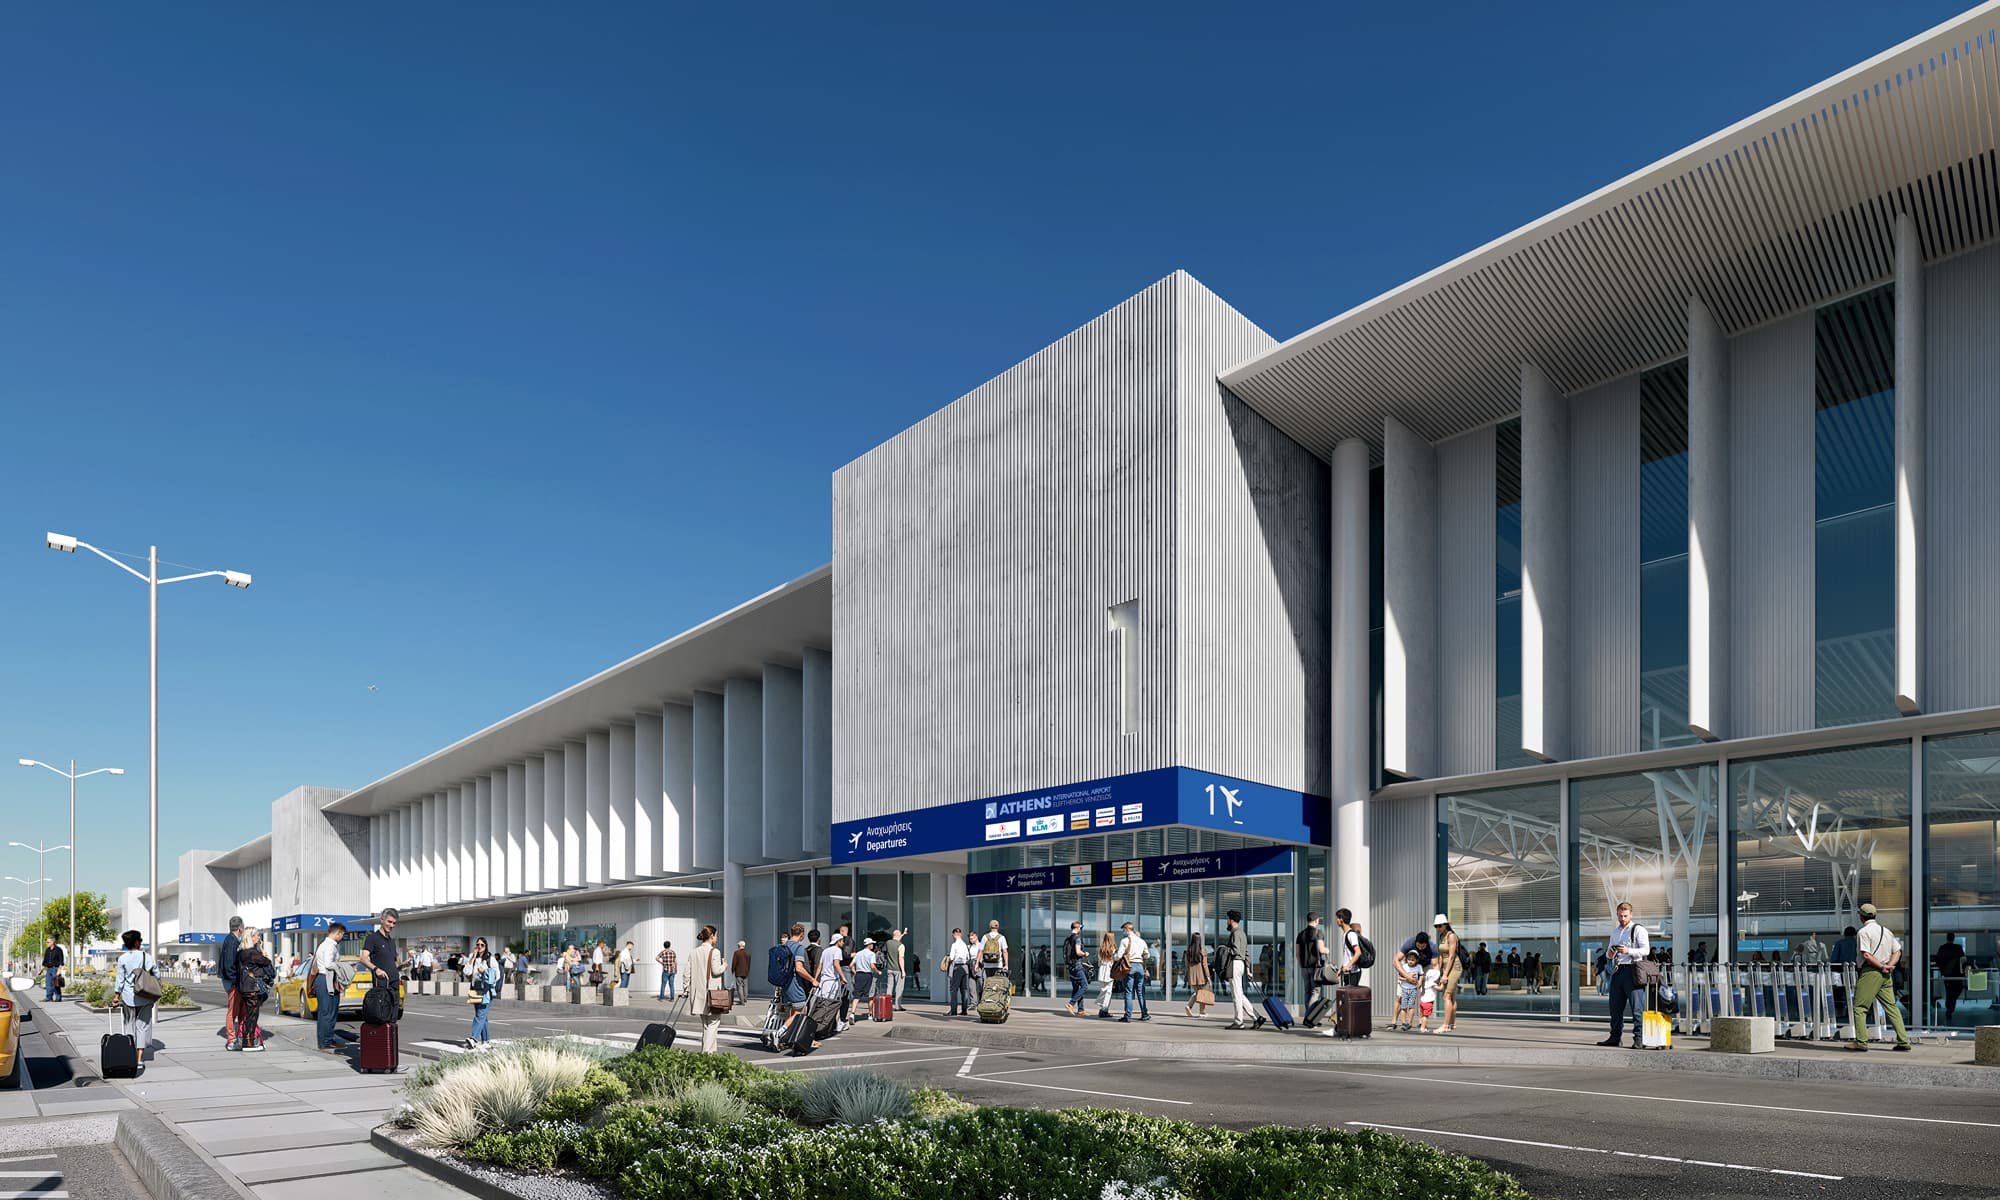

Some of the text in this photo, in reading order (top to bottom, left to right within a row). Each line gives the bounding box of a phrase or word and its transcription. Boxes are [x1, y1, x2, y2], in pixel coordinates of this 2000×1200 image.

[1108, 598, 1138, 736] 1
[1053, 786, 1112, 800] INTERNATIONAL AIRPORT
[1205, 784, 1215, 815] 1
[1000, 796, 1052, 816] ATHENS
[866, 821, 913, 837] Αναχωρήσεις
[1032, 824, 1048, 832] KLM
[866, 837, 907, 852] Departures
[1215, 857, 1221, 870] 1
[1050, 872, 1055, 883] 1
[1172, 867, 1206, 876] Departures
[314, 916, 321, 927] 2
[524, 905, 569, 930] coffee shop
[200, 934, 206, 942] 3
